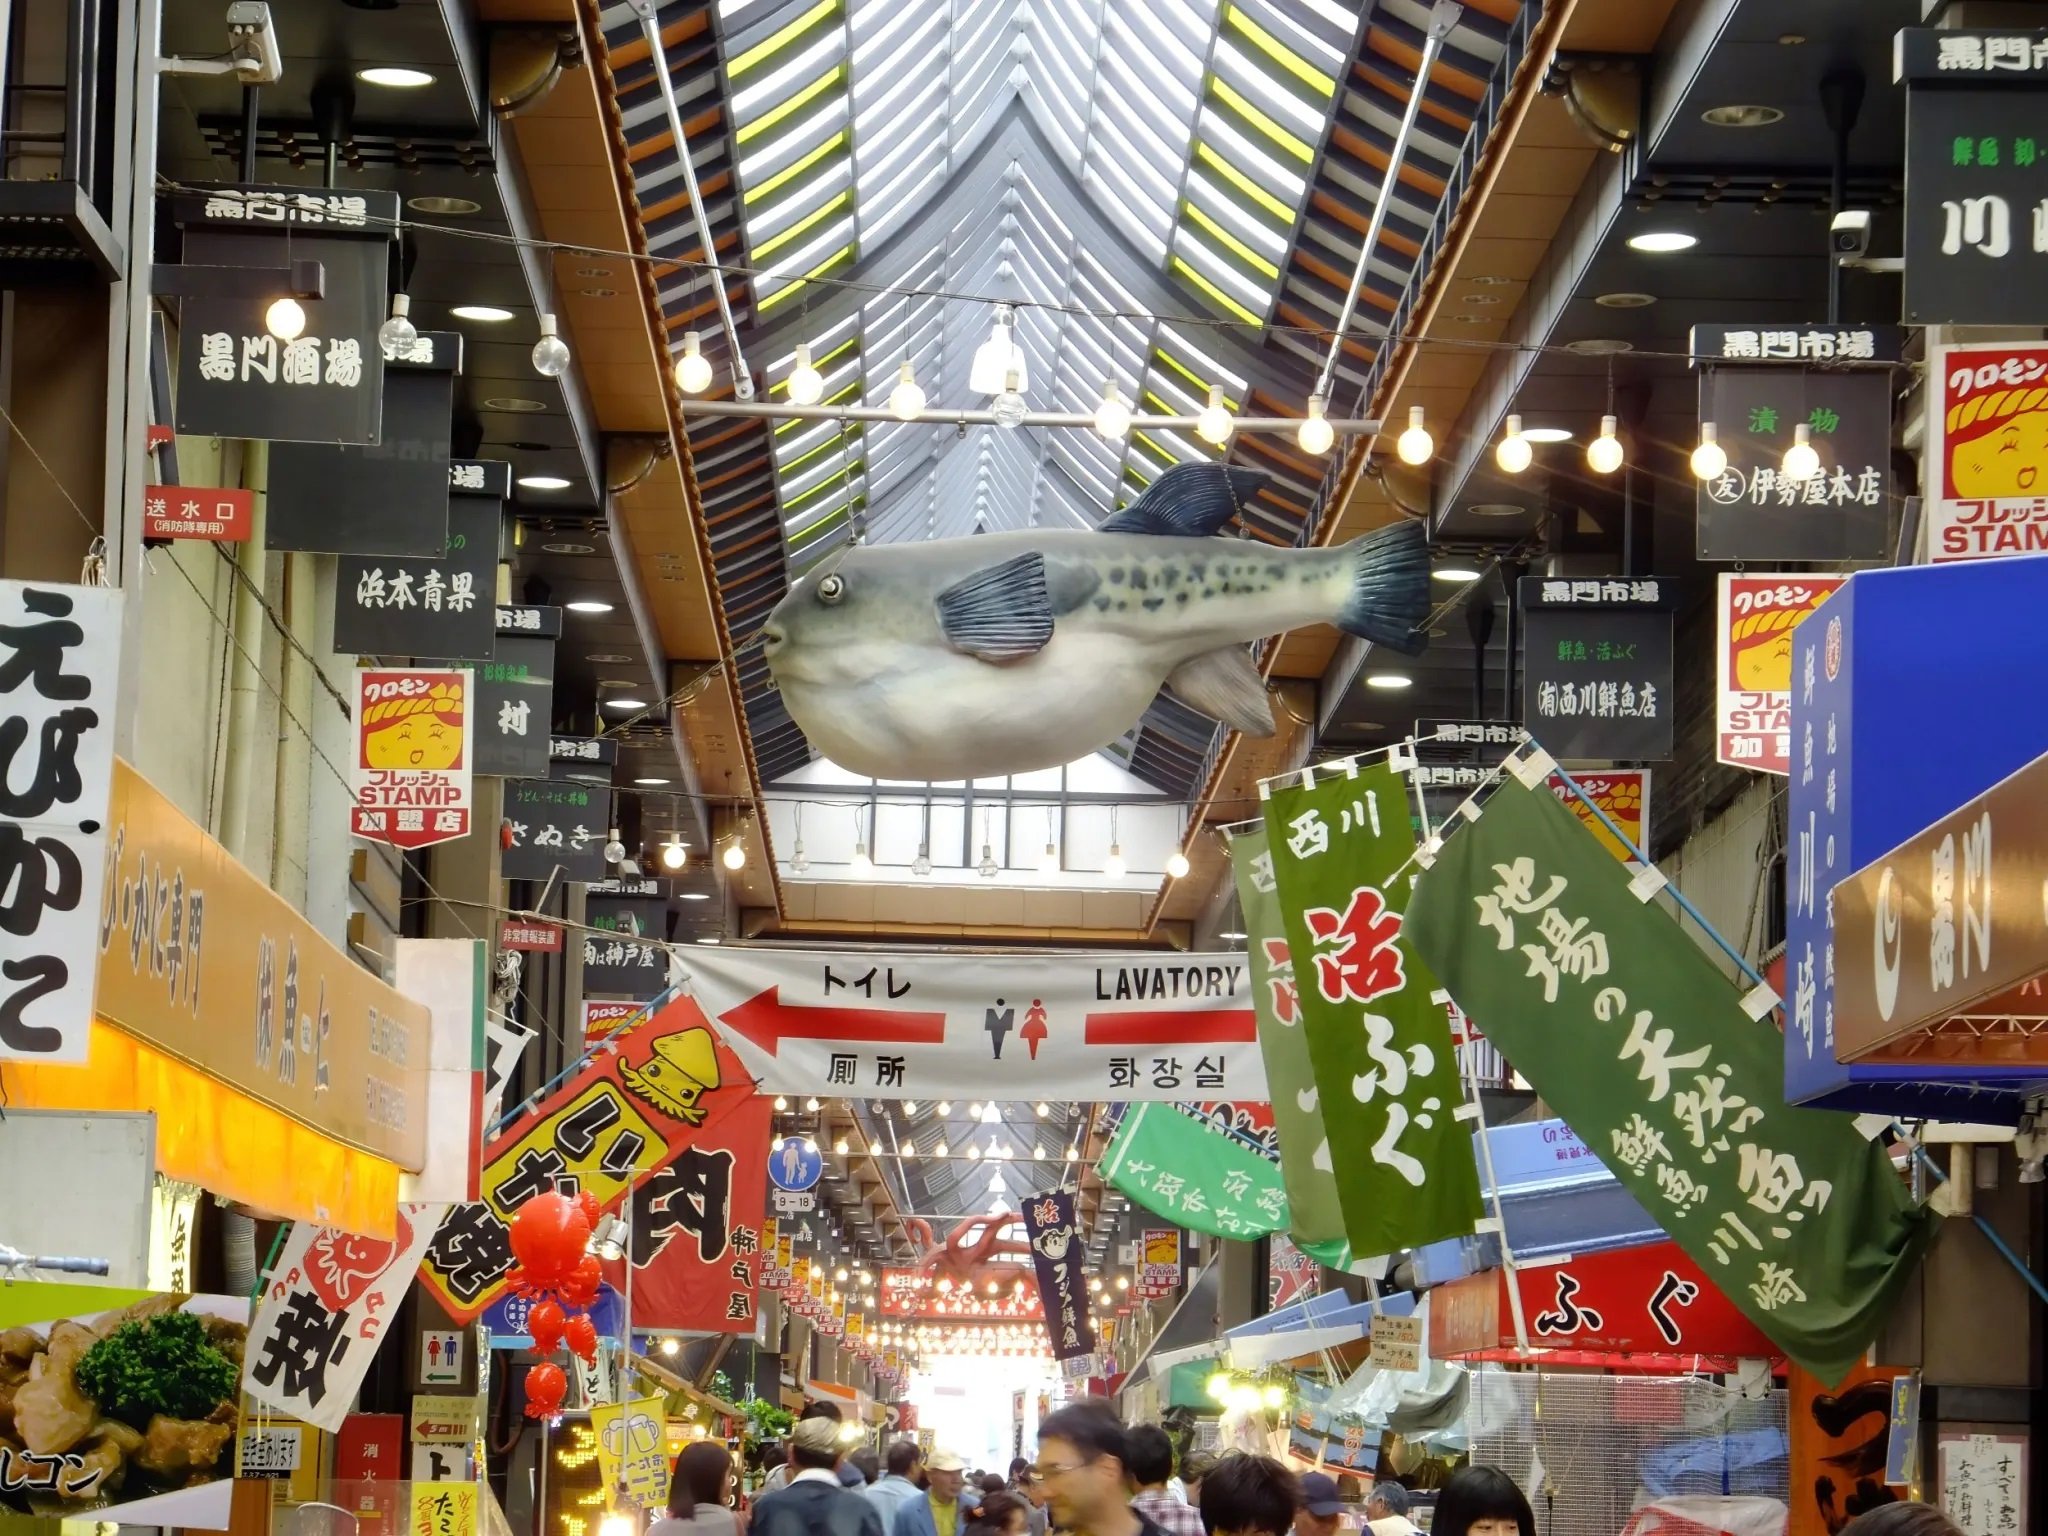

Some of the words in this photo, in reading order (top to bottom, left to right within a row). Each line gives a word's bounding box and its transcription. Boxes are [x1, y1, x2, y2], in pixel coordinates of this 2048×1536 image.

[1723, 331, 1874, 358] 黒門市場
[199, 332, 362, 387] 黒門酒場
[1748, 407, 1840, 434] 漬物
[146, 499, 234, 519] 送水口
[357, 567, 476, 613] 浜本青果
[1542, 581, 1660, 603] 黒門市場
[1733, 585, 1812, 615] クロモン
[364, 677, 431, 703] クロモン
[368, 770, 450, 787] フレッシュ
[359, 786, 462, 806] STAMP
[358, 809, 462, 832] 加盟店
[824, 965, 911, 999] トイレ
[1096, 966, 1241, 1000] LAVATORY
[1108, 1056, 1226, 1089] 화장실
[1353, 1012, 1441, 1187] ふぐ
[1535, 1271, 1699, 1346] ふぐ
